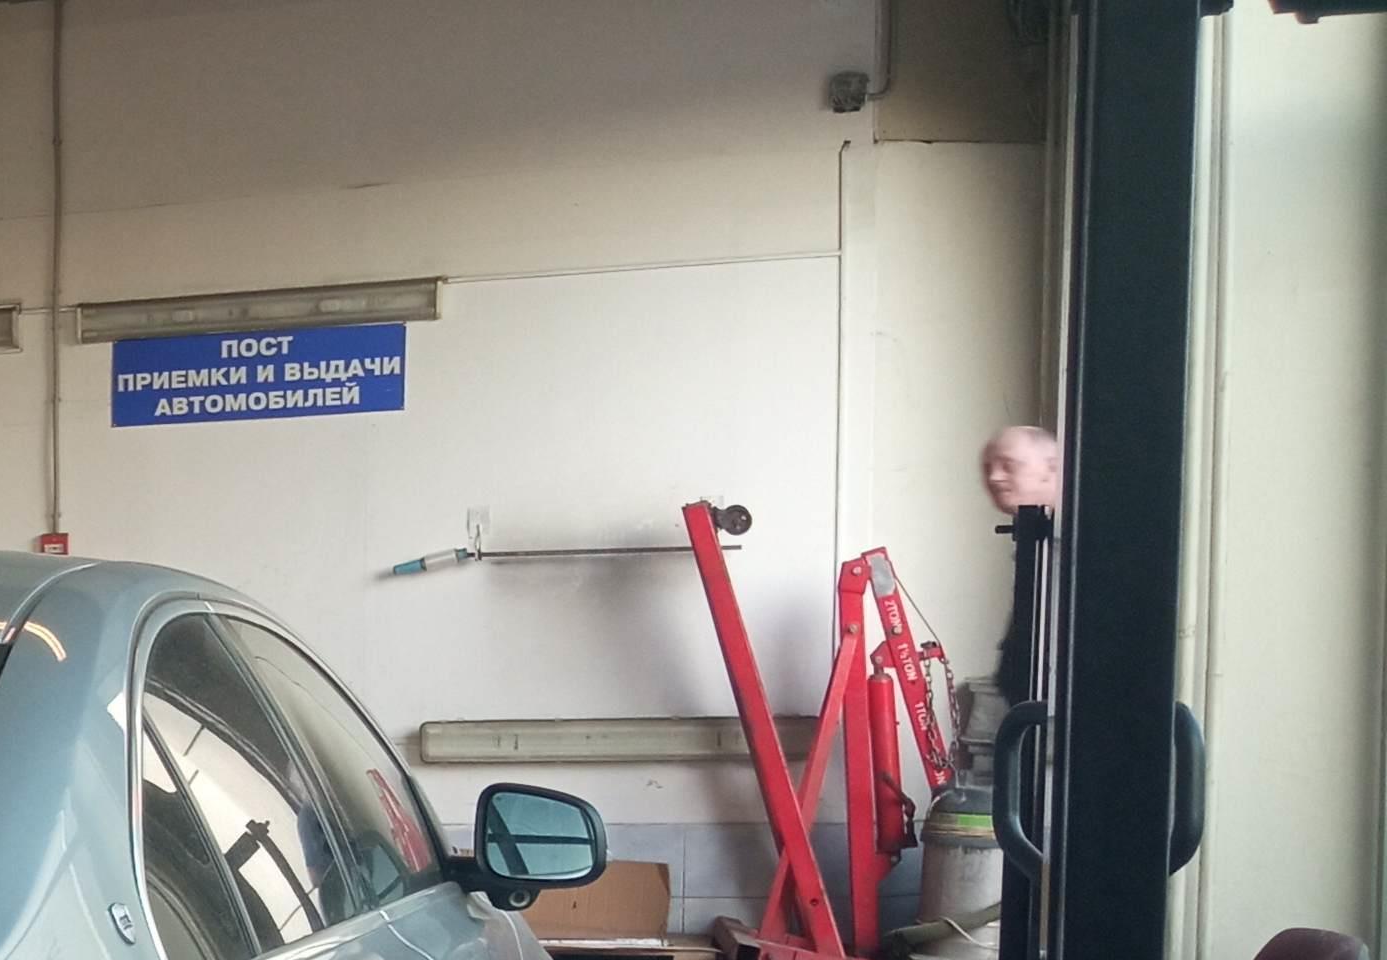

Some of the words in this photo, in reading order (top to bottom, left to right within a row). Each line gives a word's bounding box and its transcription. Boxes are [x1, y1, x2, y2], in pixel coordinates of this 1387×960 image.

[221, 336, 293, 358] ПОСТ
[117, 366, 247, 392] ПРИЕМКИ
[257, 365, 274, 383] И
[285, 356, 401, 383] ВЫДАЧИ
[154, 382, 360, 416] АВТОМОБИЛЕЙ
